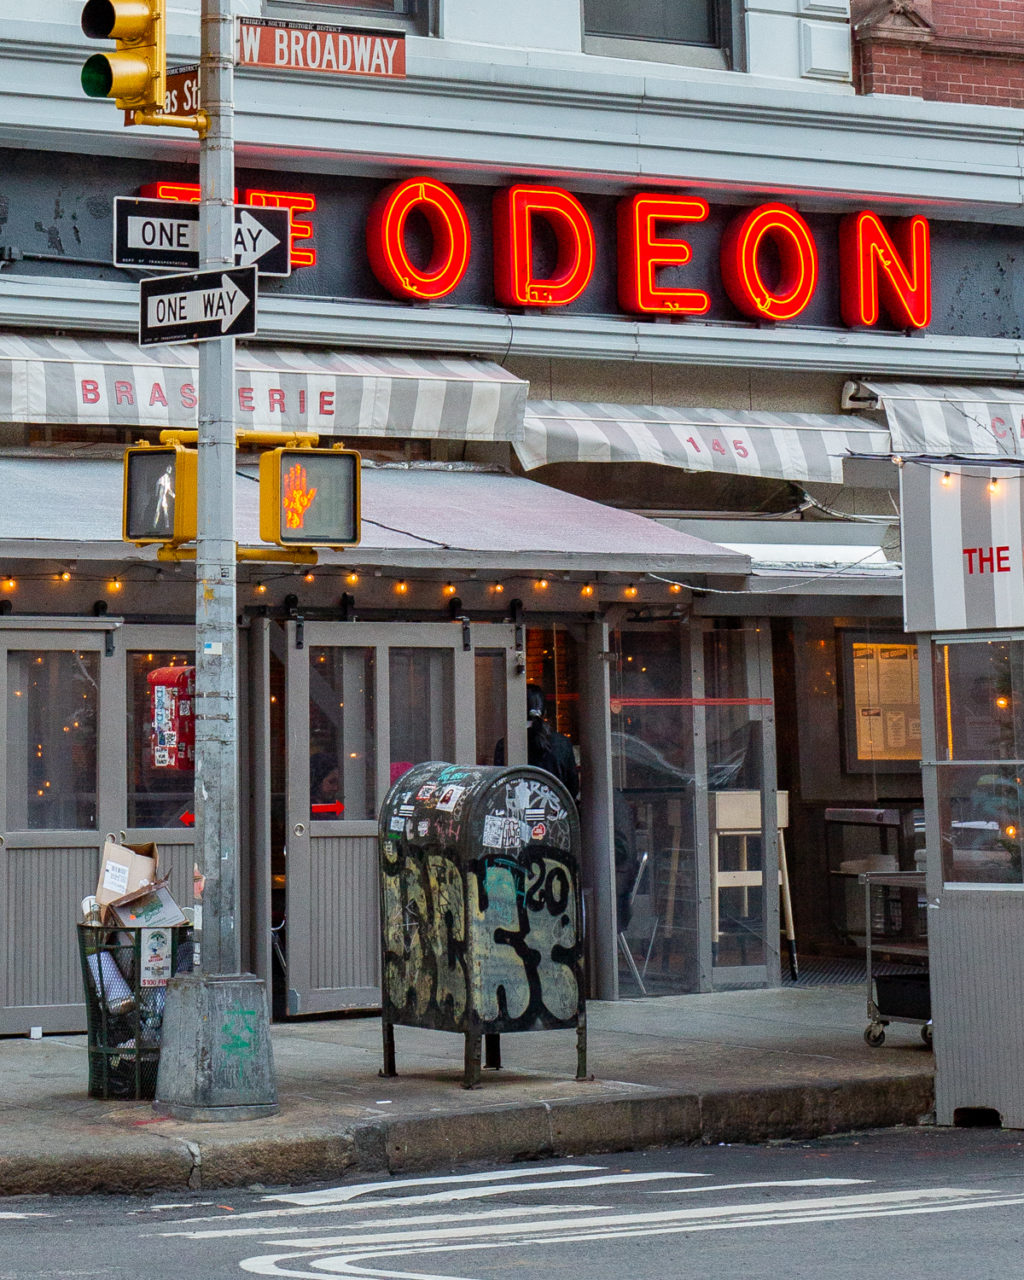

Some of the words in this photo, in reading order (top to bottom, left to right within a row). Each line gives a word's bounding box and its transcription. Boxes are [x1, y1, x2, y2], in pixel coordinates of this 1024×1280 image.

[241, 25, 261, 64] W
[275, 29, 398, 75] BROADWAY
[142, 221, 189, 248] ONE
[234, 227, 262, 252] AY
[367, 176, 932, 329] ODEON
[156, 296, 187, 323] ONE
[203, 290, 238, 318] WAY
[81, 379, 335, 415] BRASERIE
[686, 436, 749, 458] 145
[962, 545, 1011, 574] THE
